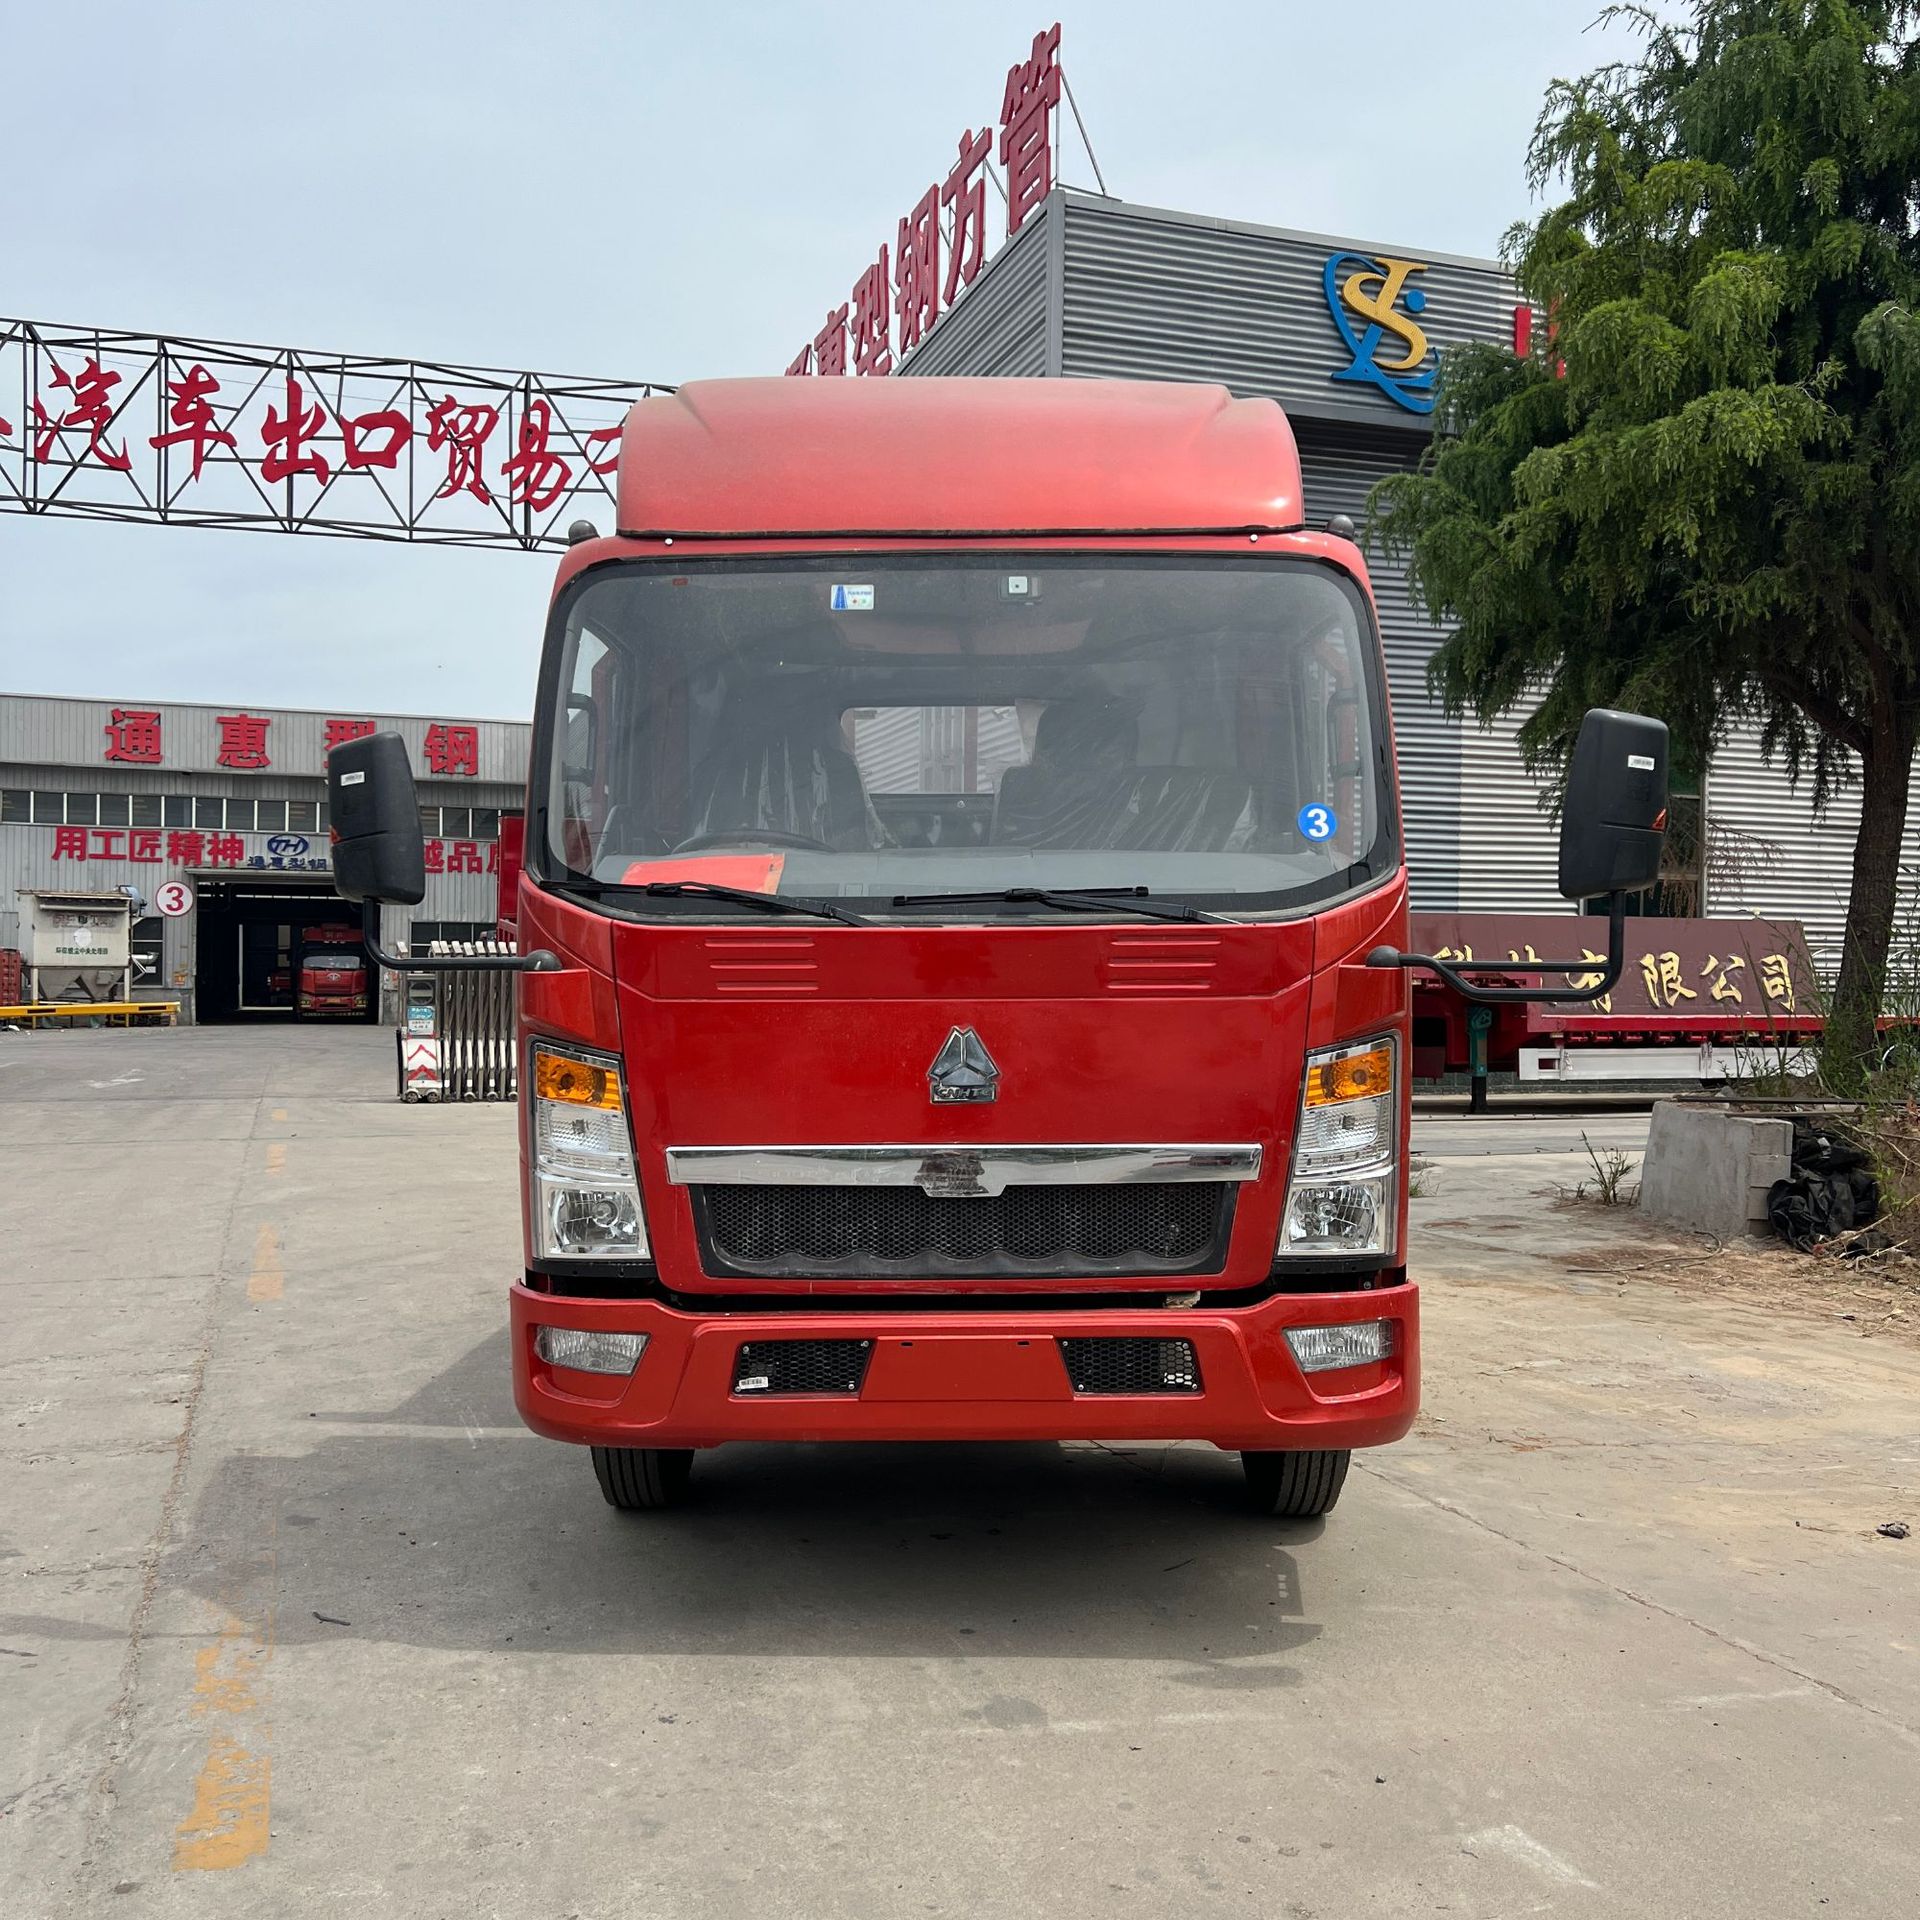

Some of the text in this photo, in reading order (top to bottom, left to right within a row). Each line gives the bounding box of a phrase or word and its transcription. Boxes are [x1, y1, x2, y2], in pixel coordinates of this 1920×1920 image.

[784, 22, 1061, 376] 惠型钢方管
[0, 356, 623, 512] 汽车出口贸易
[1307, 808, 1329, 837] 3
[51, 827, 244, 868] 用工匠精神
[165, 886, 185, 911] 3
